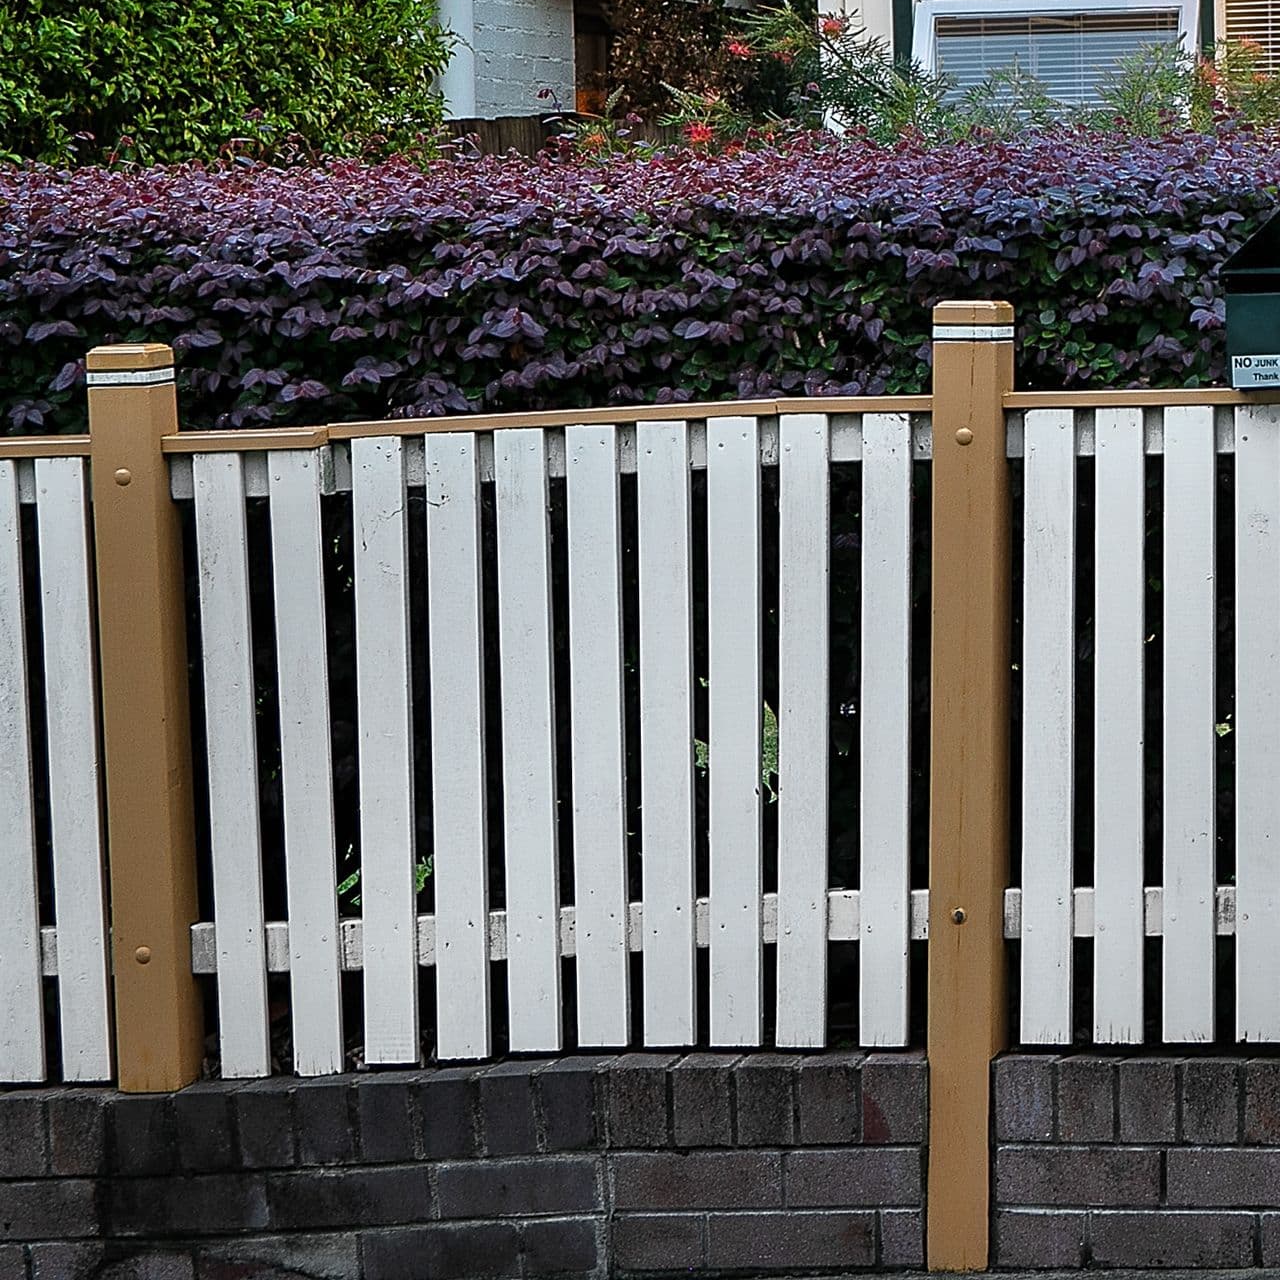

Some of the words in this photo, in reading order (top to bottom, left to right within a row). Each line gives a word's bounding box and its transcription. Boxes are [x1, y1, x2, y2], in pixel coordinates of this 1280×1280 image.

[1234, 357, 1252, 368] NO
[1254, 359, 1279, 368] JUNK
[1253, 372, 1279, 381] Thank
